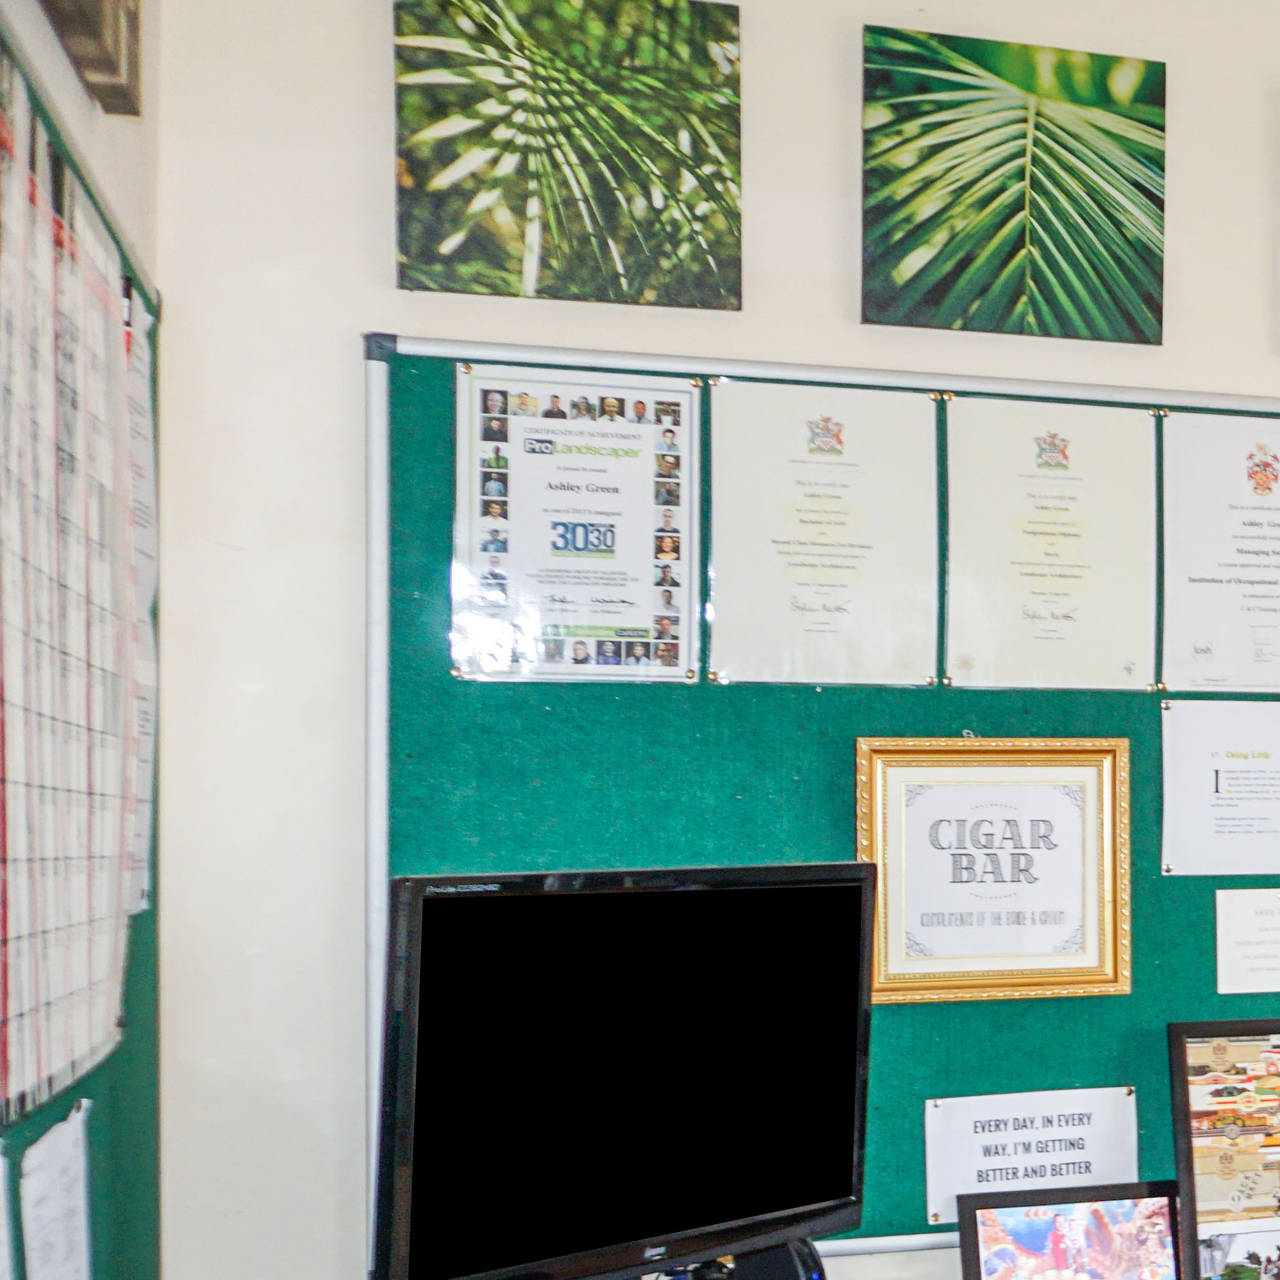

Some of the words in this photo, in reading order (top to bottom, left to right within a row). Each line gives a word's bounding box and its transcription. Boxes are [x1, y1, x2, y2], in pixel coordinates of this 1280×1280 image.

[546, 481, 581, 494] Ashley
[585, 483, 620, 494] Green
[928, 819, 1059, 851] CIGAR
[949, 853, 1039, 884] BAR
[973, 1118, 1009, 1134] EVERY
[1042, 1114, 1054, 1129] IN
[1057, 1112, 1093, 1128] EVERY
[1014, 1141, 1032, 1156] I'M
[1035, 1137, 1085, 1153] GETTING
[976, 1166, 1019, 1183] BETTER
[1022, 1164, 1047, 1180] AND
[1050, 1160, 1092, 1177] BETTER
